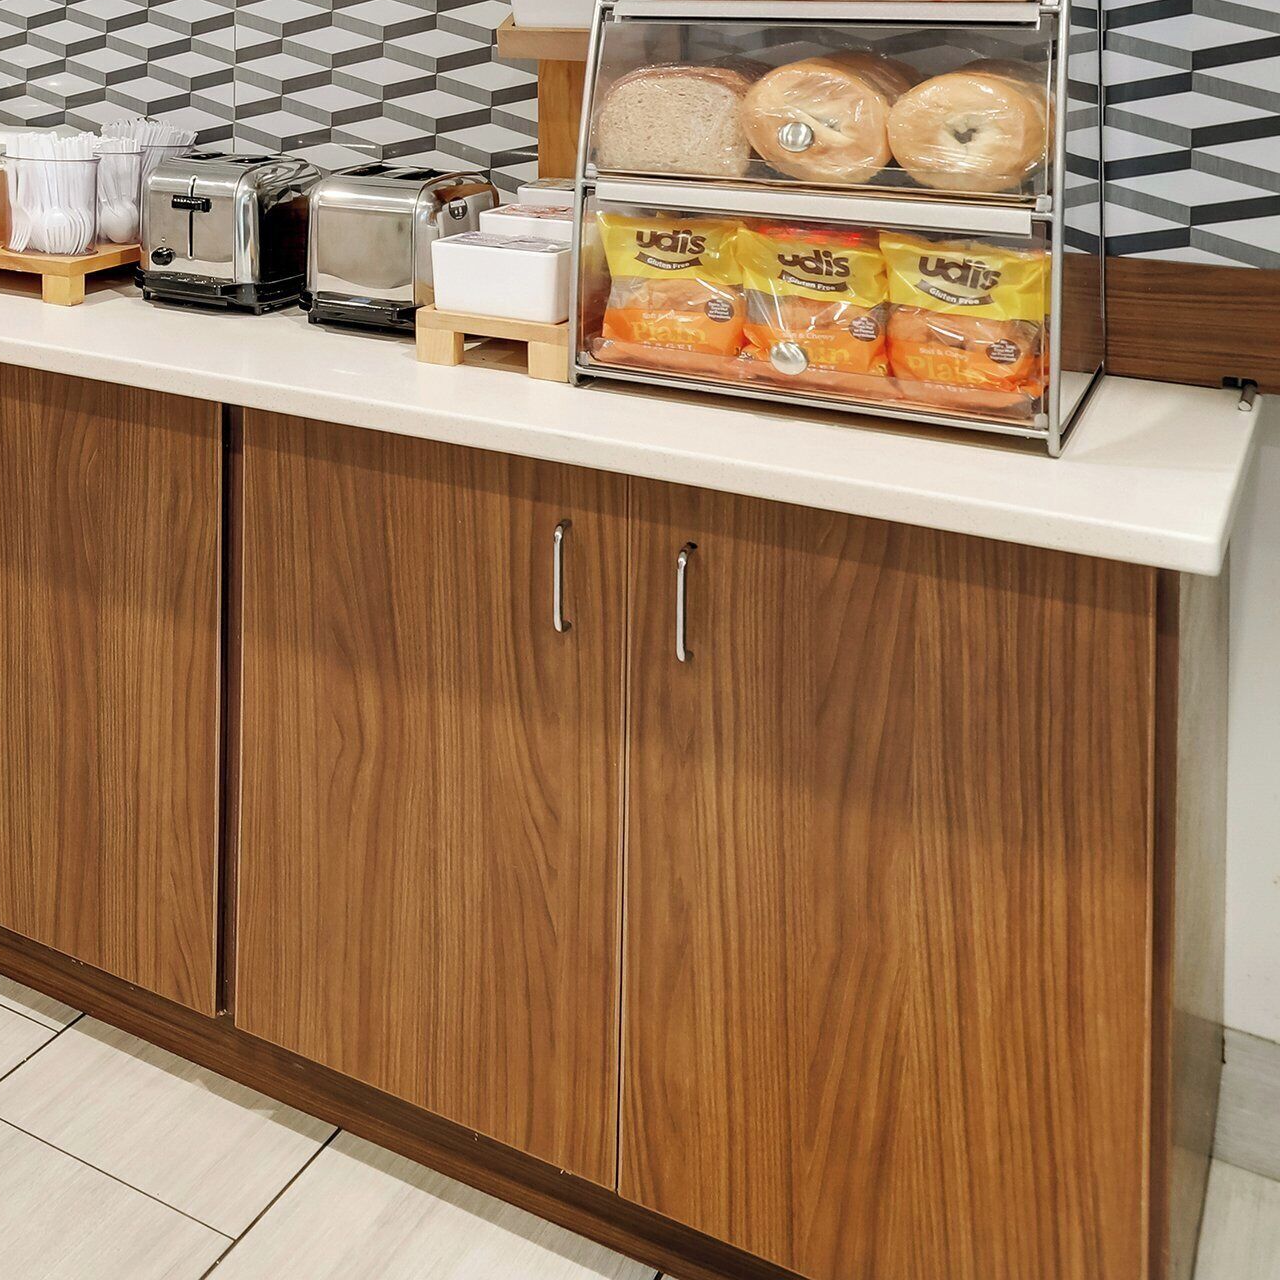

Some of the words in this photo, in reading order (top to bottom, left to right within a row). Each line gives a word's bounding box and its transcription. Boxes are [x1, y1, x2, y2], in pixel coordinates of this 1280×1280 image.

[646, 257, 672, 269] Gluten
[788, 276, 816, 289] Gluten
[816, 283, 837, 292] Free
[929, 288, 957, 304] Gluten
[958, 297, 980, 305] Free
